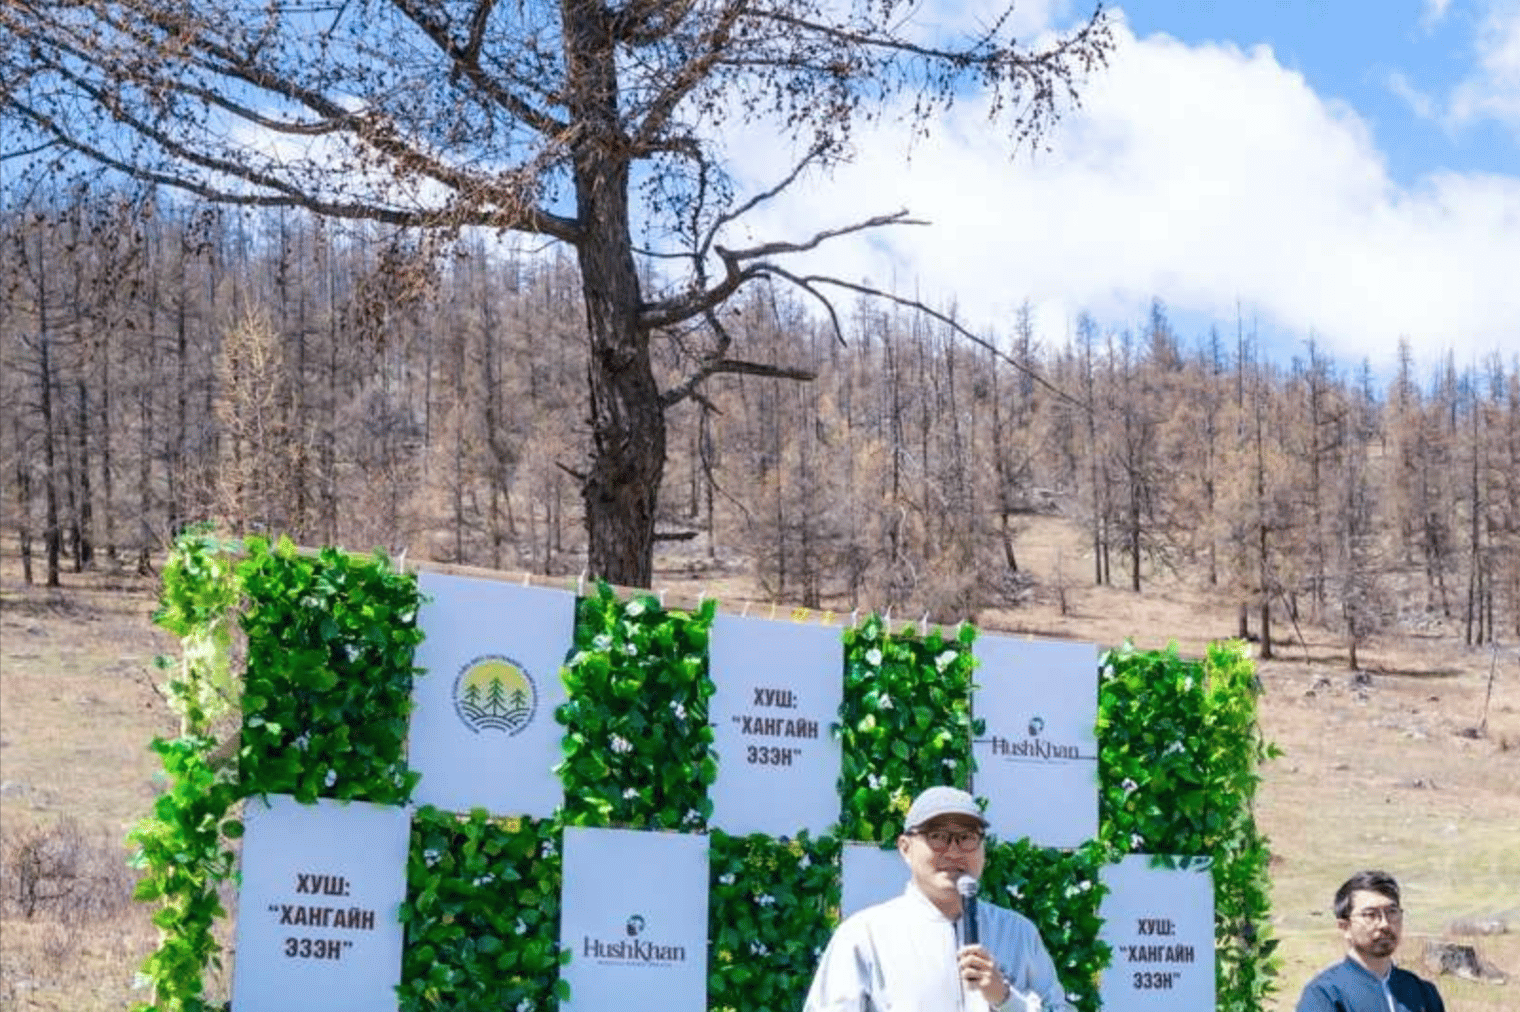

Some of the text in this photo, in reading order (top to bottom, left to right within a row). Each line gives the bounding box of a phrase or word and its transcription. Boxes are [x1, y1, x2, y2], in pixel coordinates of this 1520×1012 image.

[753, 687, 798, 710] ХУШ:
[731, 715, 819, 740] “ХАНГАЙН
[992, 736, 1080, 760] HushKhan
[296, 873, 350, 896] ХУШ:
[268, 904, 376, 931] “ХАНГАЙН
[1138, 918, 1177, 936] ХУШ:
[583, 935, 686, 962] HushKhan
[1119, 943, 1195, 963] “ХАНГАЙН
